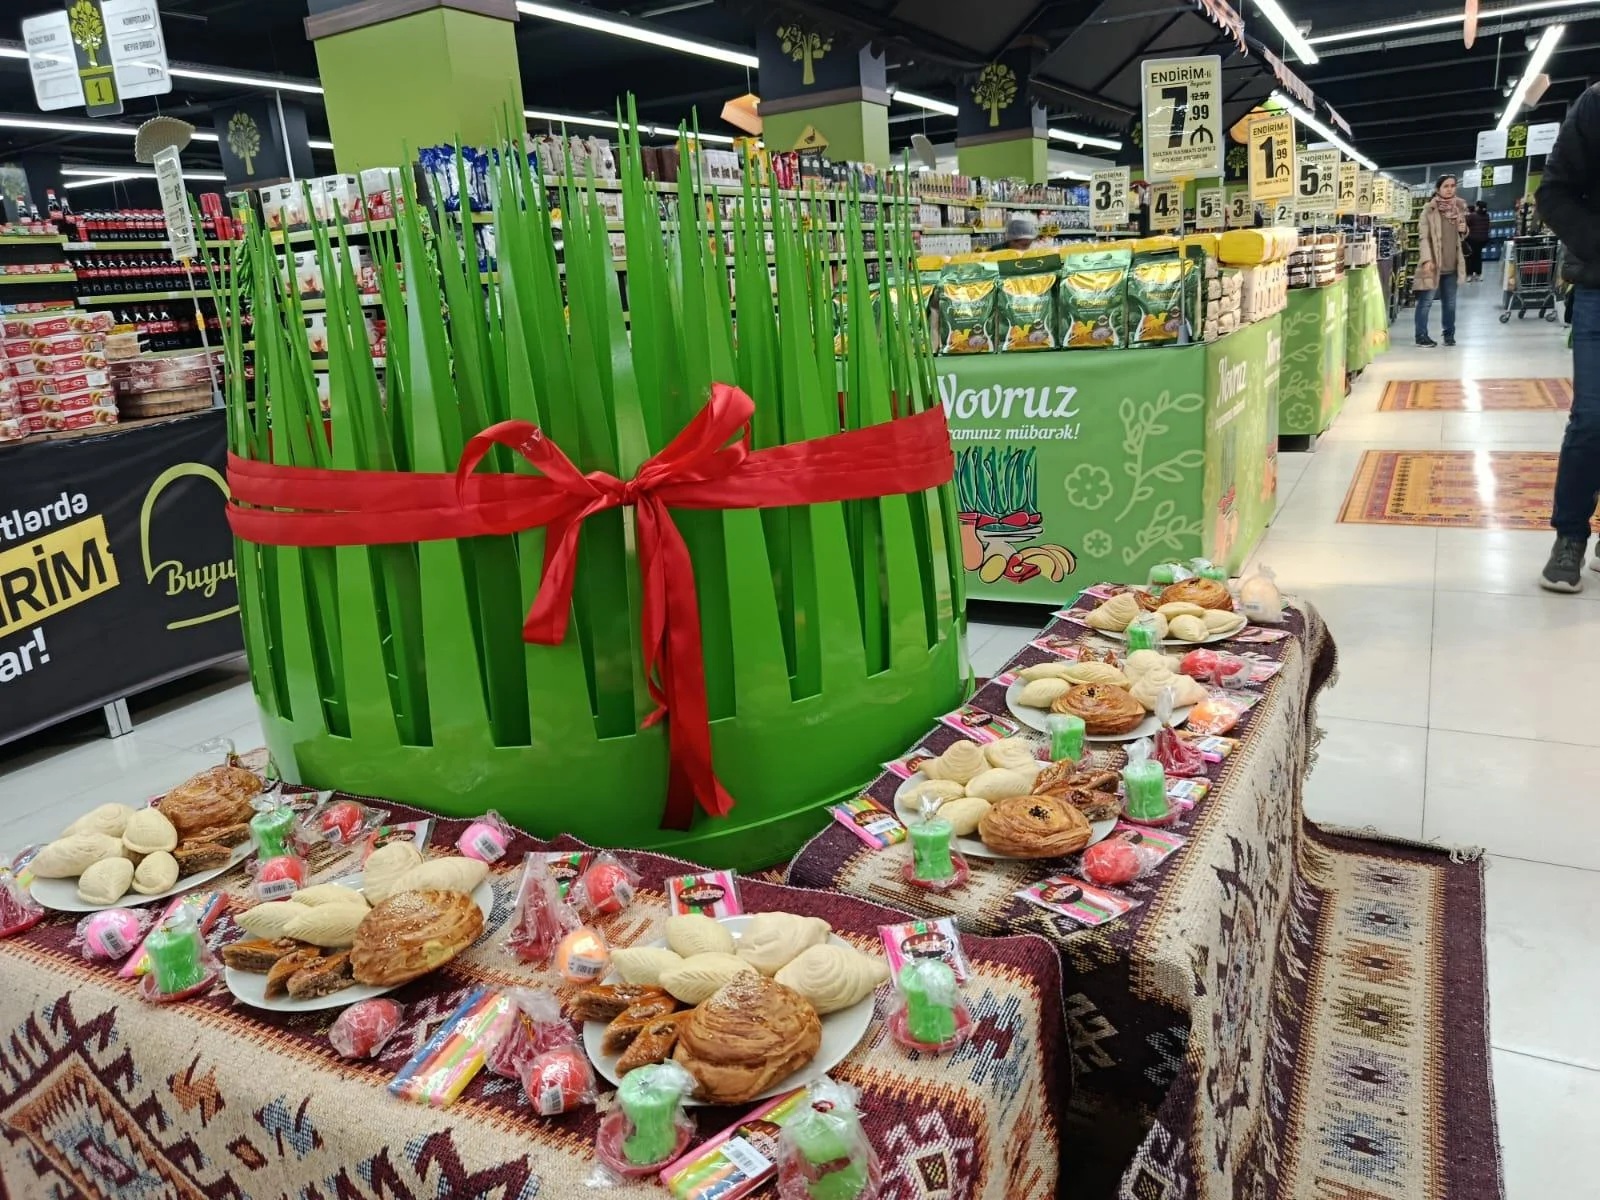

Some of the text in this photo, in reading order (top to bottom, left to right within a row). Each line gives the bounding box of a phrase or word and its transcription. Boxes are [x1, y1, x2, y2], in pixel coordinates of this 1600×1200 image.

[95, 81, 105, 102] 1
[1161, 86, 1188, 149] 7
[1189, 104, 1209, 121] .99
[1259, 136, 1274, 179] 1
[1300, 164, 1319, 196] 5
[1095, 181, 1111, 211] 3
[1155, 193, 1169, 217] 4
[1200, 197, 1213, 218] 5
[1233, 198, 1244, 218] 3
[1277, 206, 1287, 220] 2
[1005, 422, 1081, 440] mübarək!
[0, 492, 88, 543] tlərdə
[0, 537, 107, 627] RİM
